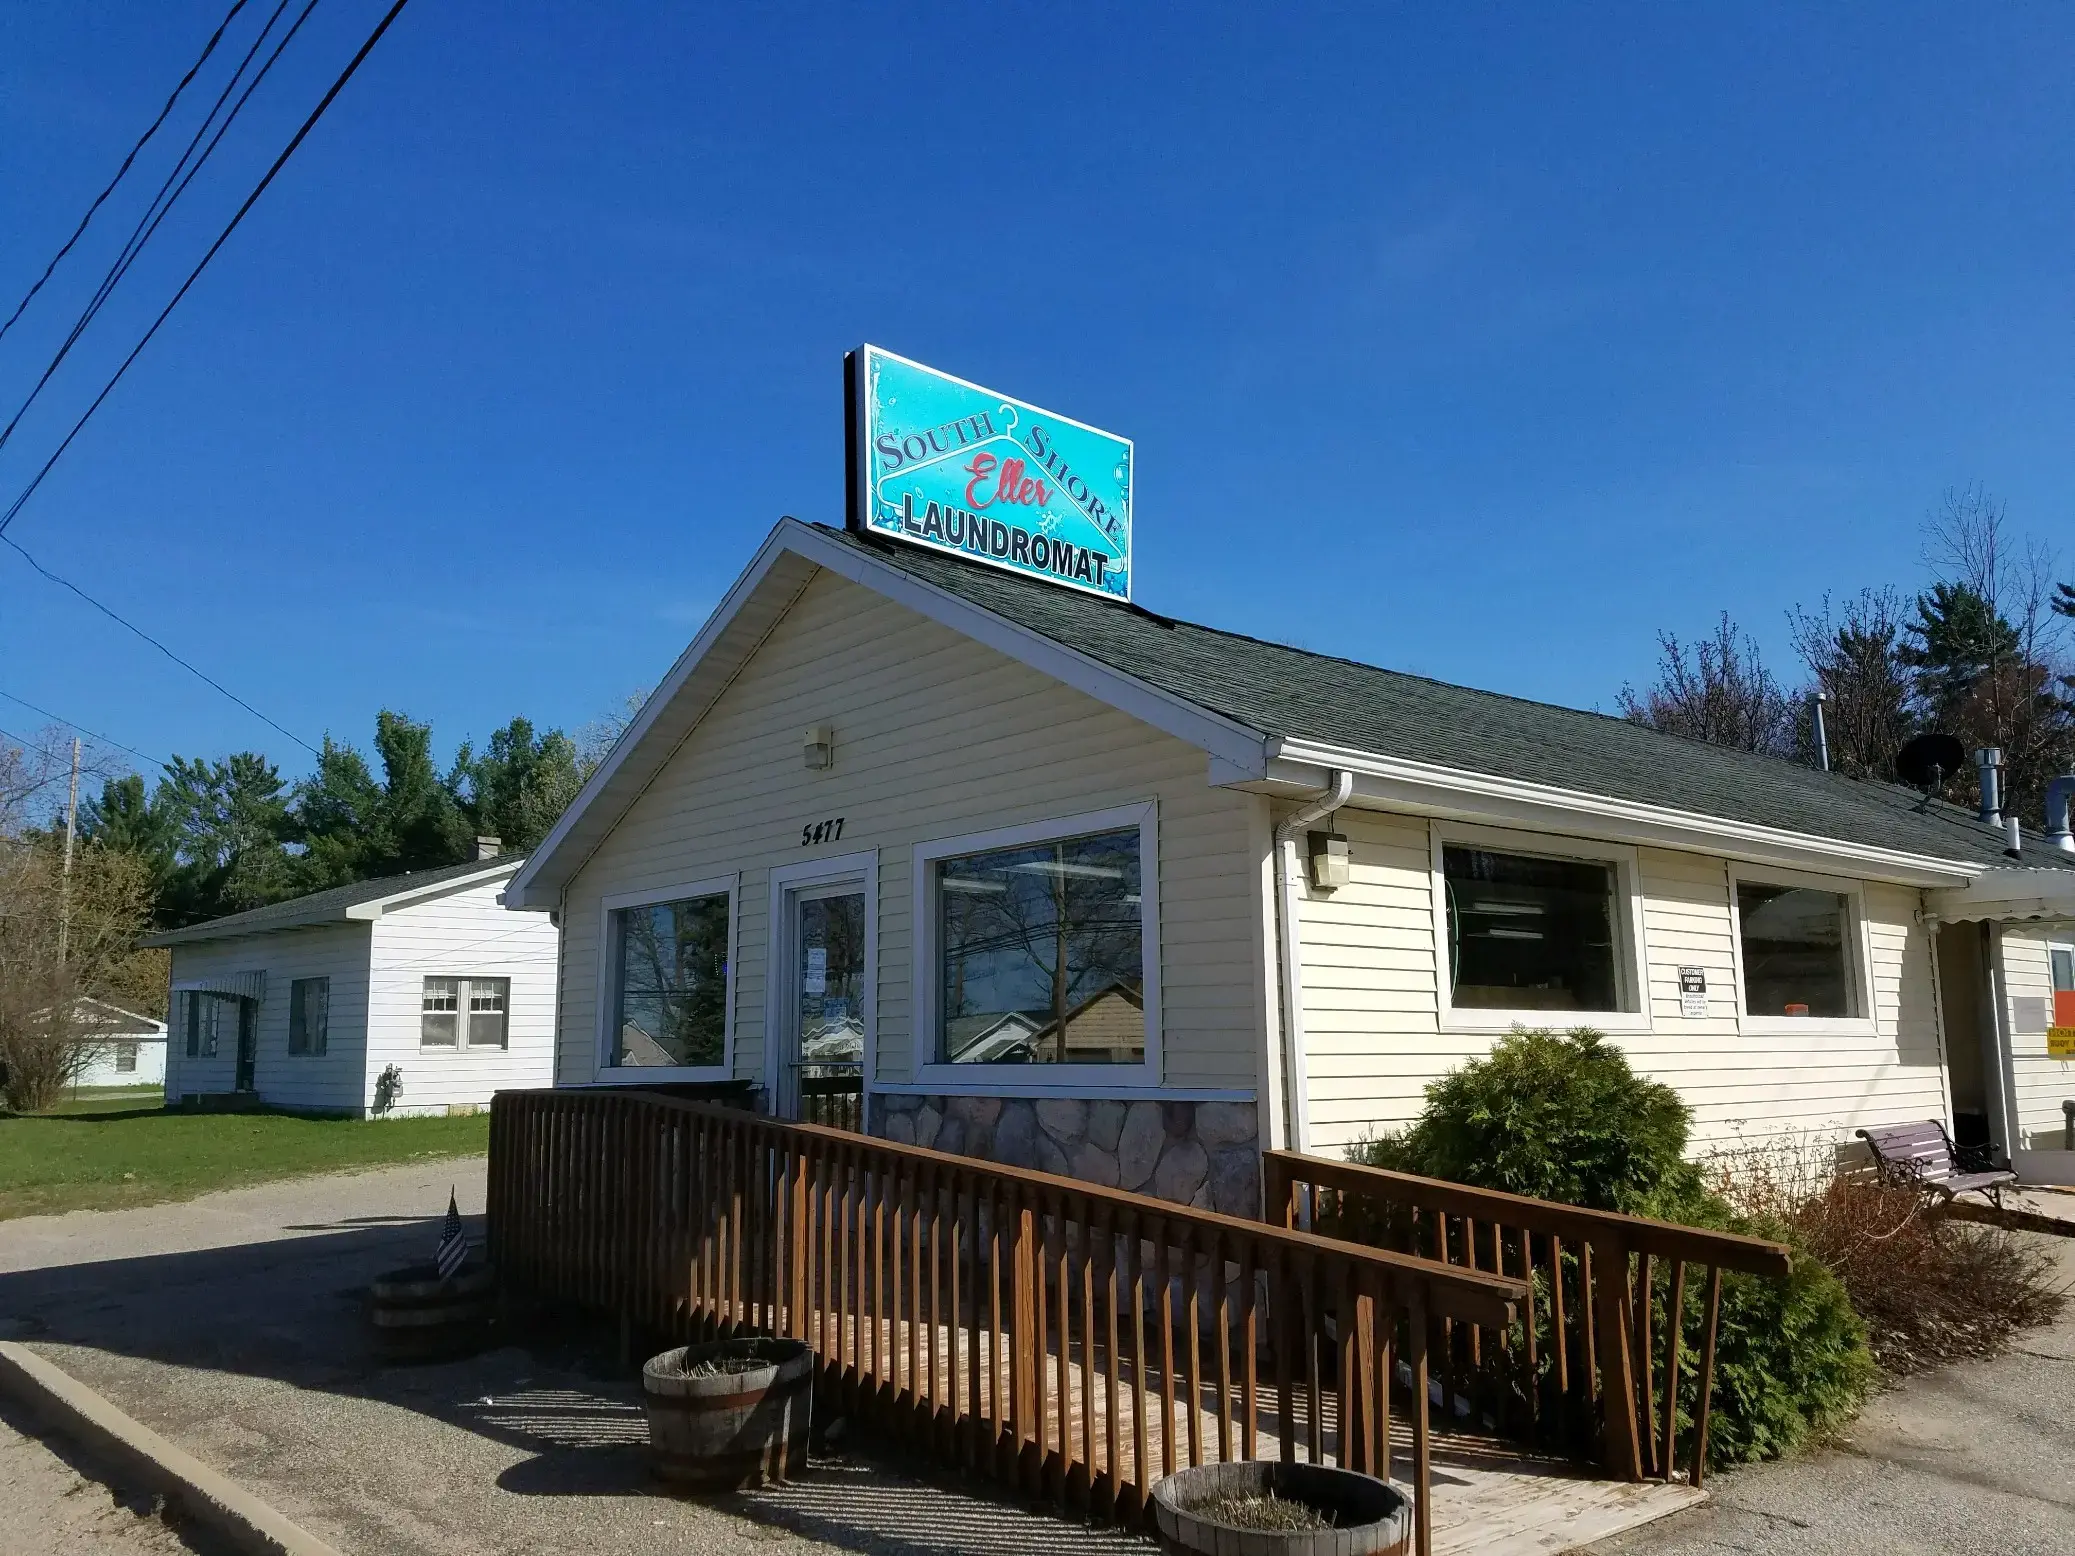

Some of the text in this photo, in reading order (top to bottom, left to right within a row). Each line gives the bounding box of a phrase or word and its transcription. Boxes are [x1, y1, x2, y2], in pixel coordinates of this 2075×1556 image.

[876, 410, 1123, 542] SOUTH SHORE
[963, 452, 1054, 510] Eller
[903, 494, 1108, 585] LAUNDROMAT
[802, 817, 845, 847] 5477
[1688, 984, 1700, 992] ONLY
